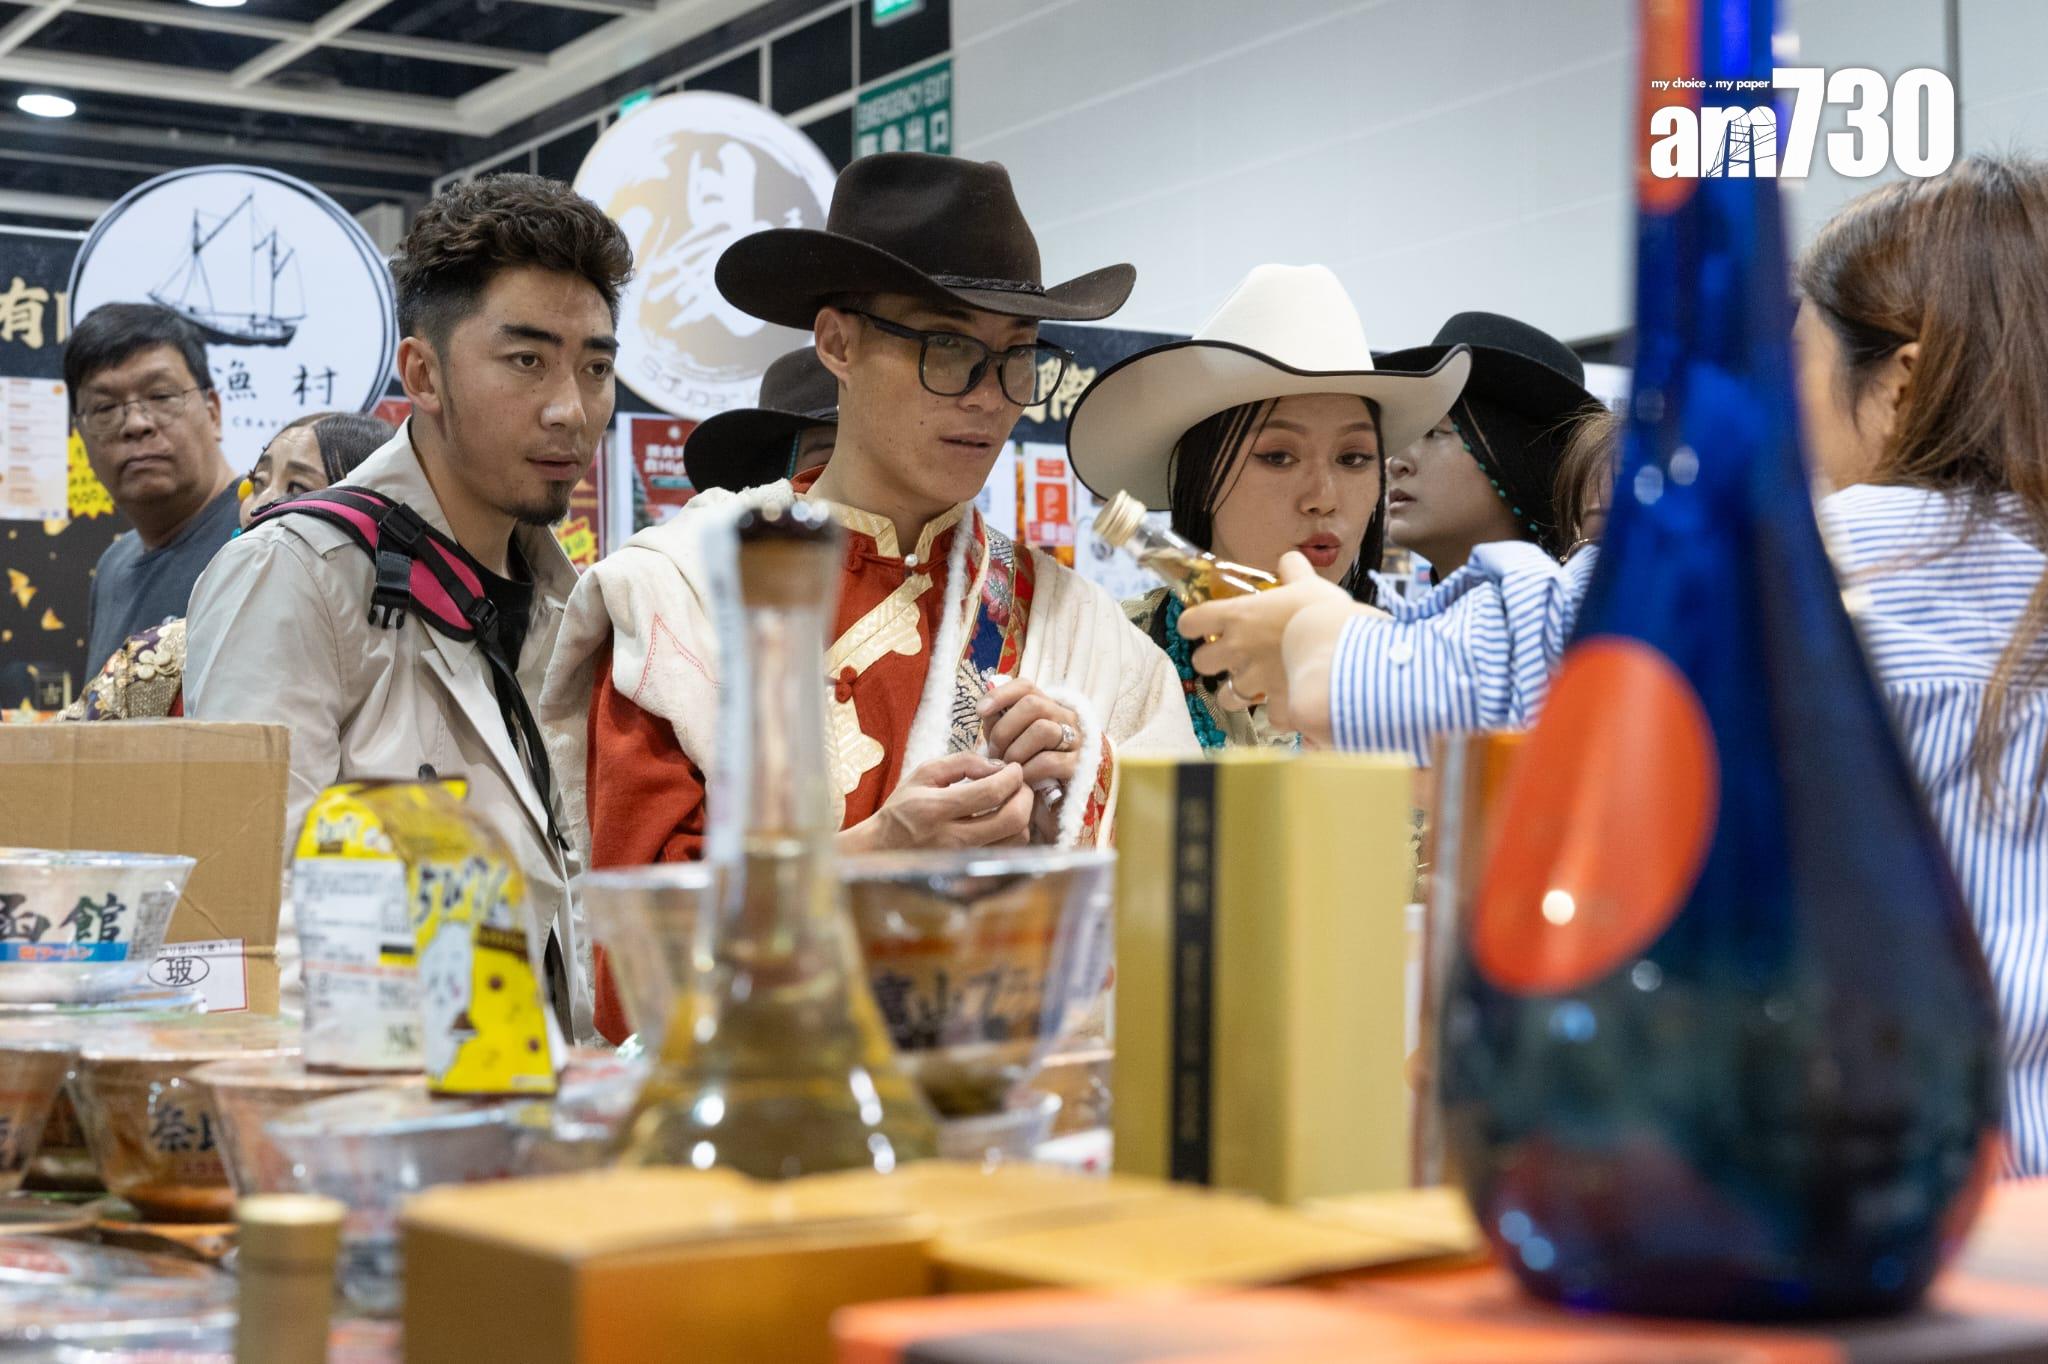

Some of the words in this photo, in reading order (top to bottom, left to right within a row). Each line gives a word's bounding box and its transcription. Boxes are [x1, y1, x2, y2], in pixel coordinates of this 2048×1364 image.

[857, 81, 922, 131] EMERGENCY
[923, 70, 950, 107] EXIT
[0, 276, 69, 349] 有
[213, 360, 337, 405] 漁村
[166, 956, 194, 984] 玻
